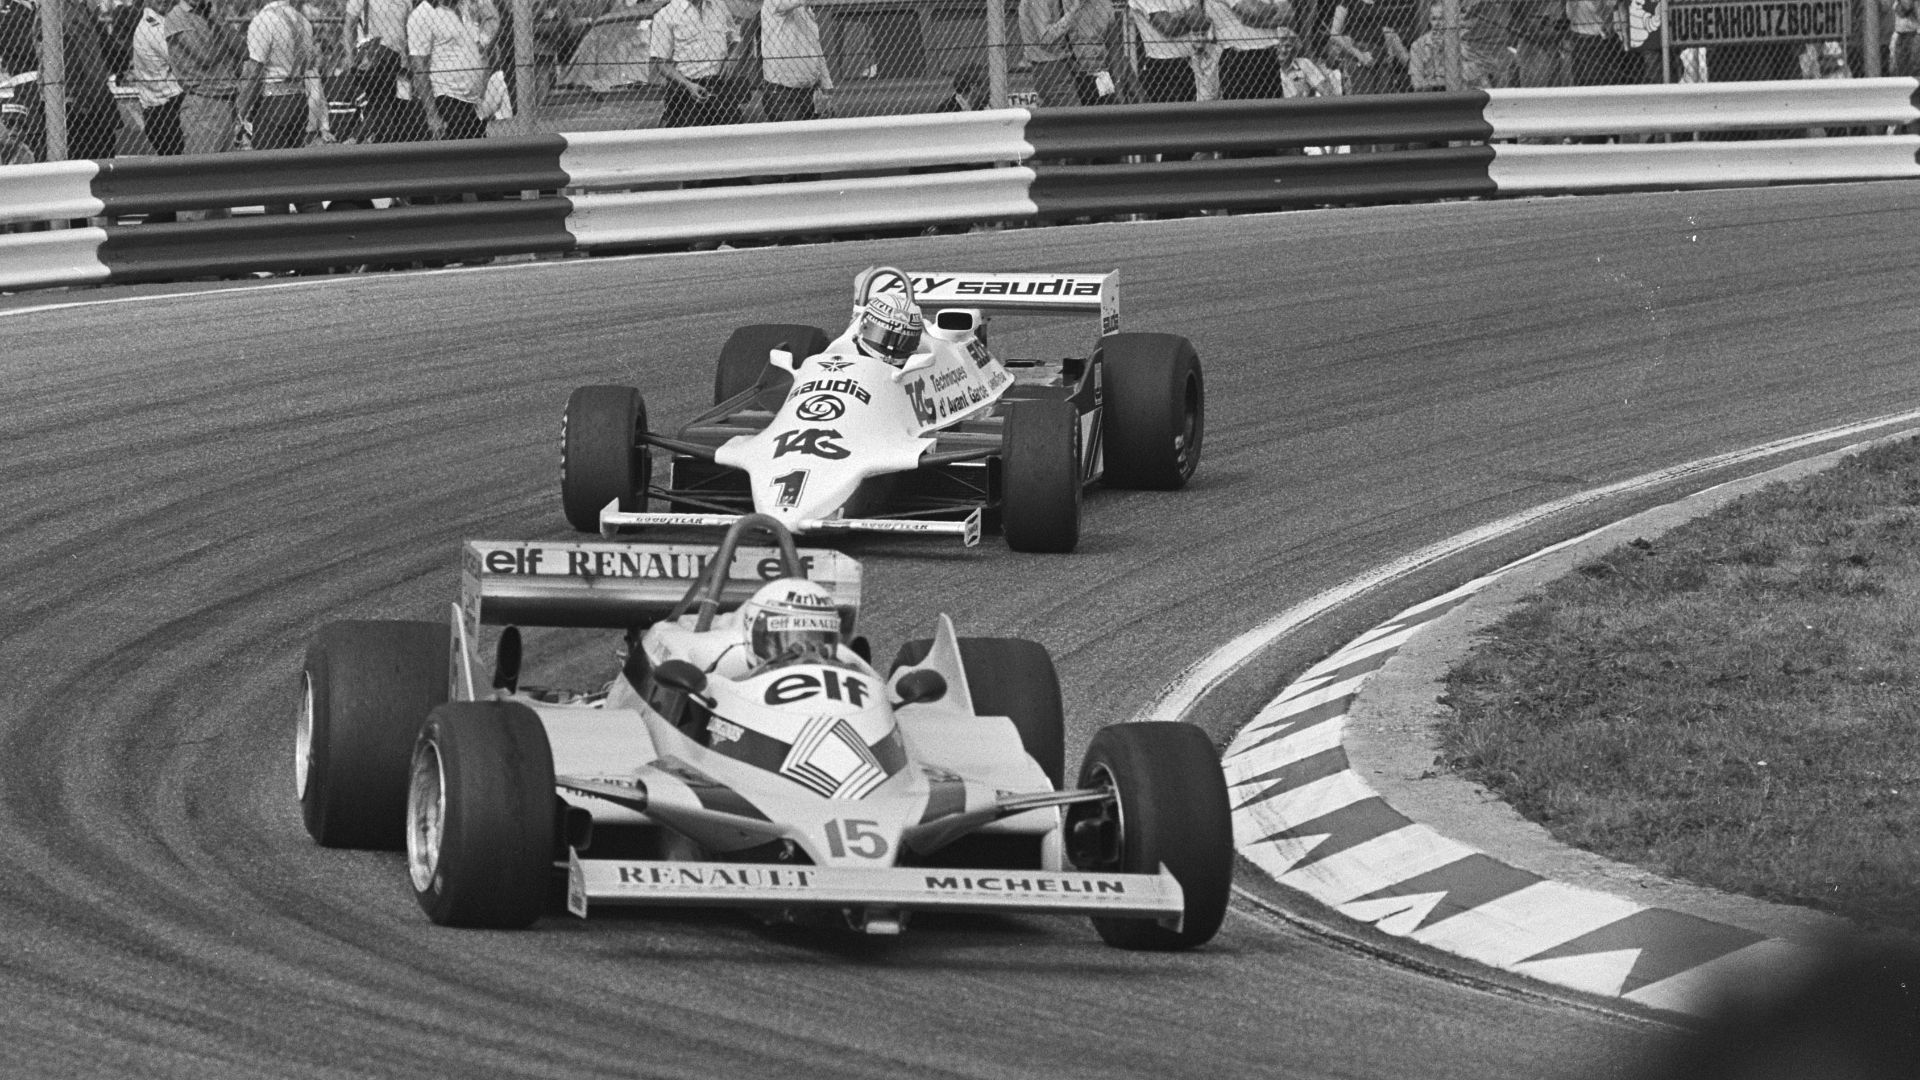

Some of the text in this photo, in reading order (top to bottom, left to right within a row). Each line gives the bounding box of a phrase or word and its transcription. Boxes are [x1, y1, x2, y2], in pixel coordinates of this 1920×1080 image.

[955, 279, 1101, 296] saudia
[788, 378, 871, 405] saudia
[773, 428, 852, 460] TAG
[771, 469, 810, 507] 1
[486, 548, 814, 581] elf RENAU ef
[764, 669, 869, 709] elf
[823, 818, 889, 860] 15
[618, 866, 815, 888] RENAULT
[925, 876, 1125, 894] MICHELIN
